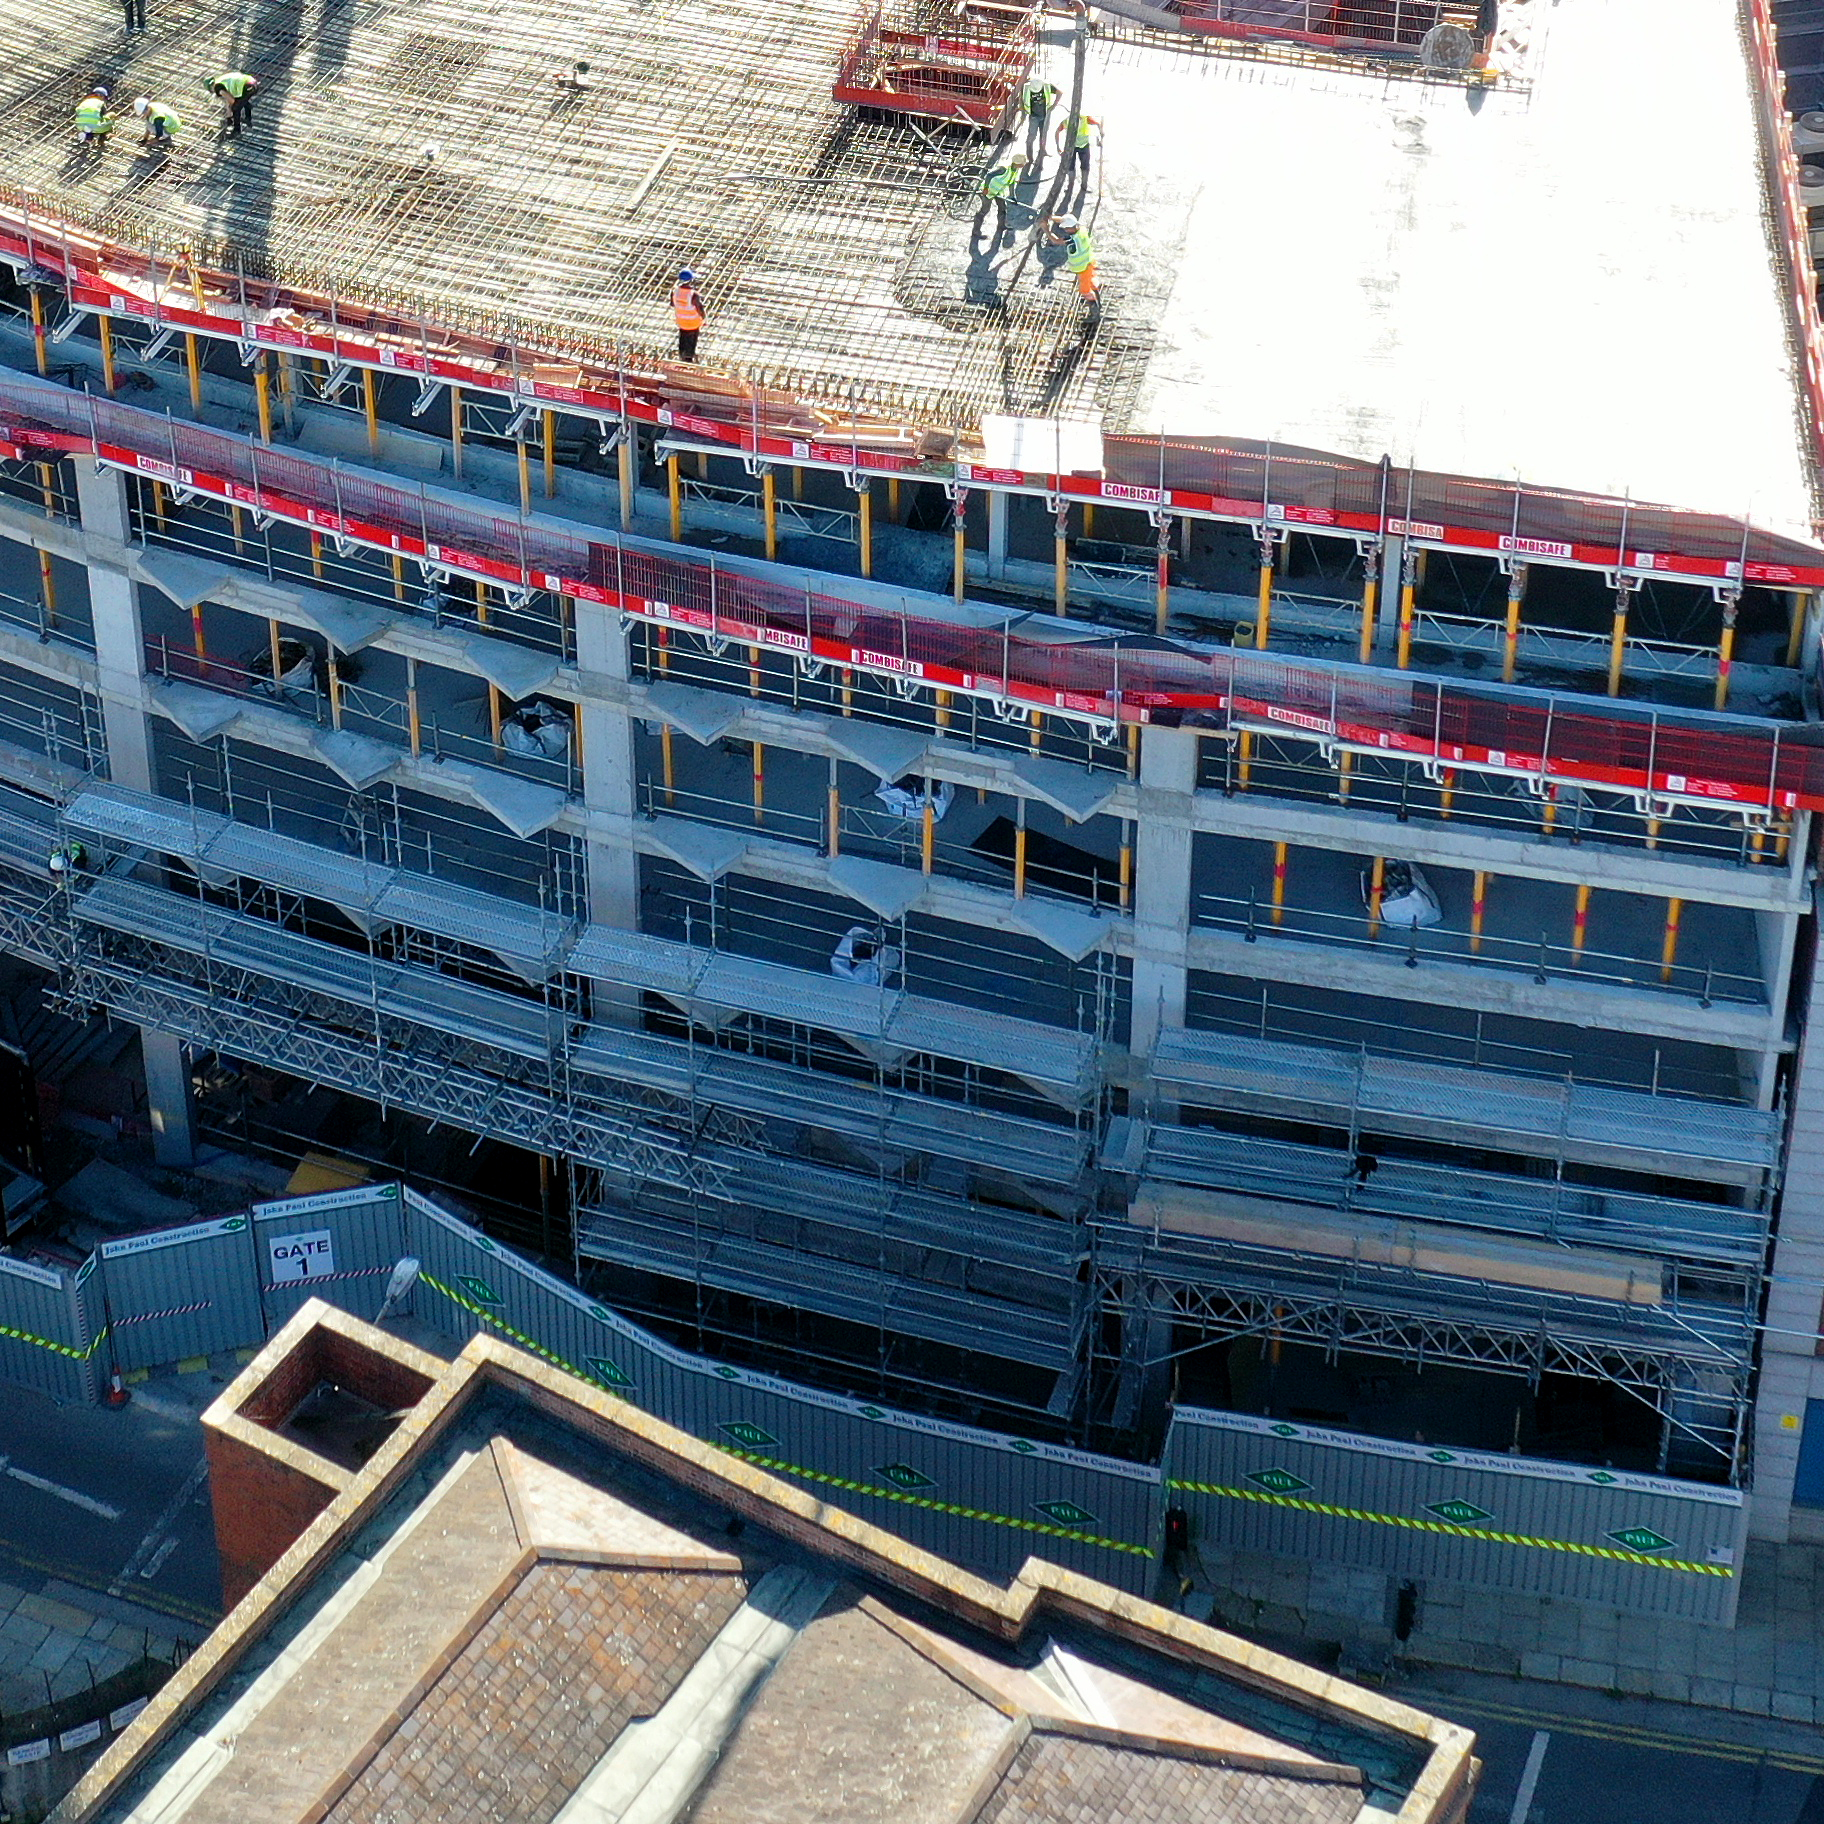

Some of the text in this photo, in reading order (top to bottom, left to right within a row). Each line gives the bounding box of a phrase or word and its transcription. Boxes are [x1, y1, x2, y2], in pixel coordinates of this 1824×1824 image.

[1503, 536, 1567, 556] COMBISAFE
[273, 1240, 330, 1260] GATE
[296, 1258, 309, 1276] 1
[468, 1279, 492, 1299] PAUL
[734, 1426, 762, 1441] PAUL
